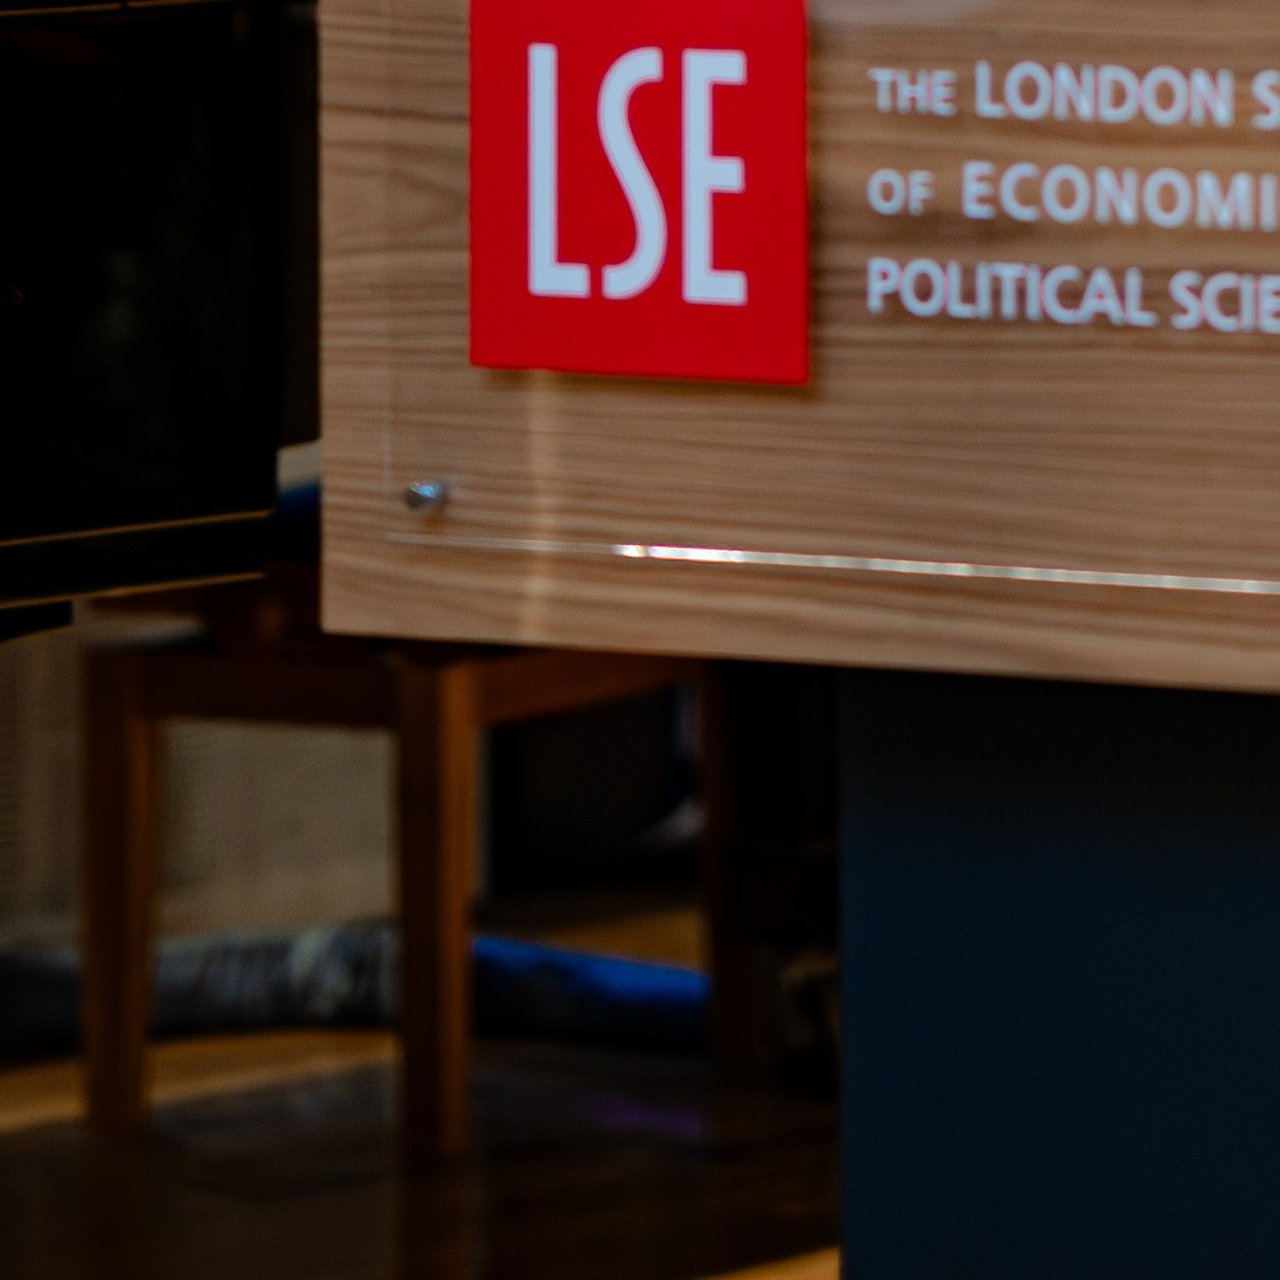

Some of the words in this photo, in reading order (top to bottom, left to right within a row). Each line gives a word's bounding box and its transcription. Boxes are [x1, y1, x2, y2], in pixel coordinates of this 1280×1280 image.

[868, 67, 956, 116] THE
[975, 60, 1233, 126] LONDON
[528, 43, 747, 305] LSE
[866, 168, 933, 215] OF
[866, 257, 1157, 327] POLITICAL
